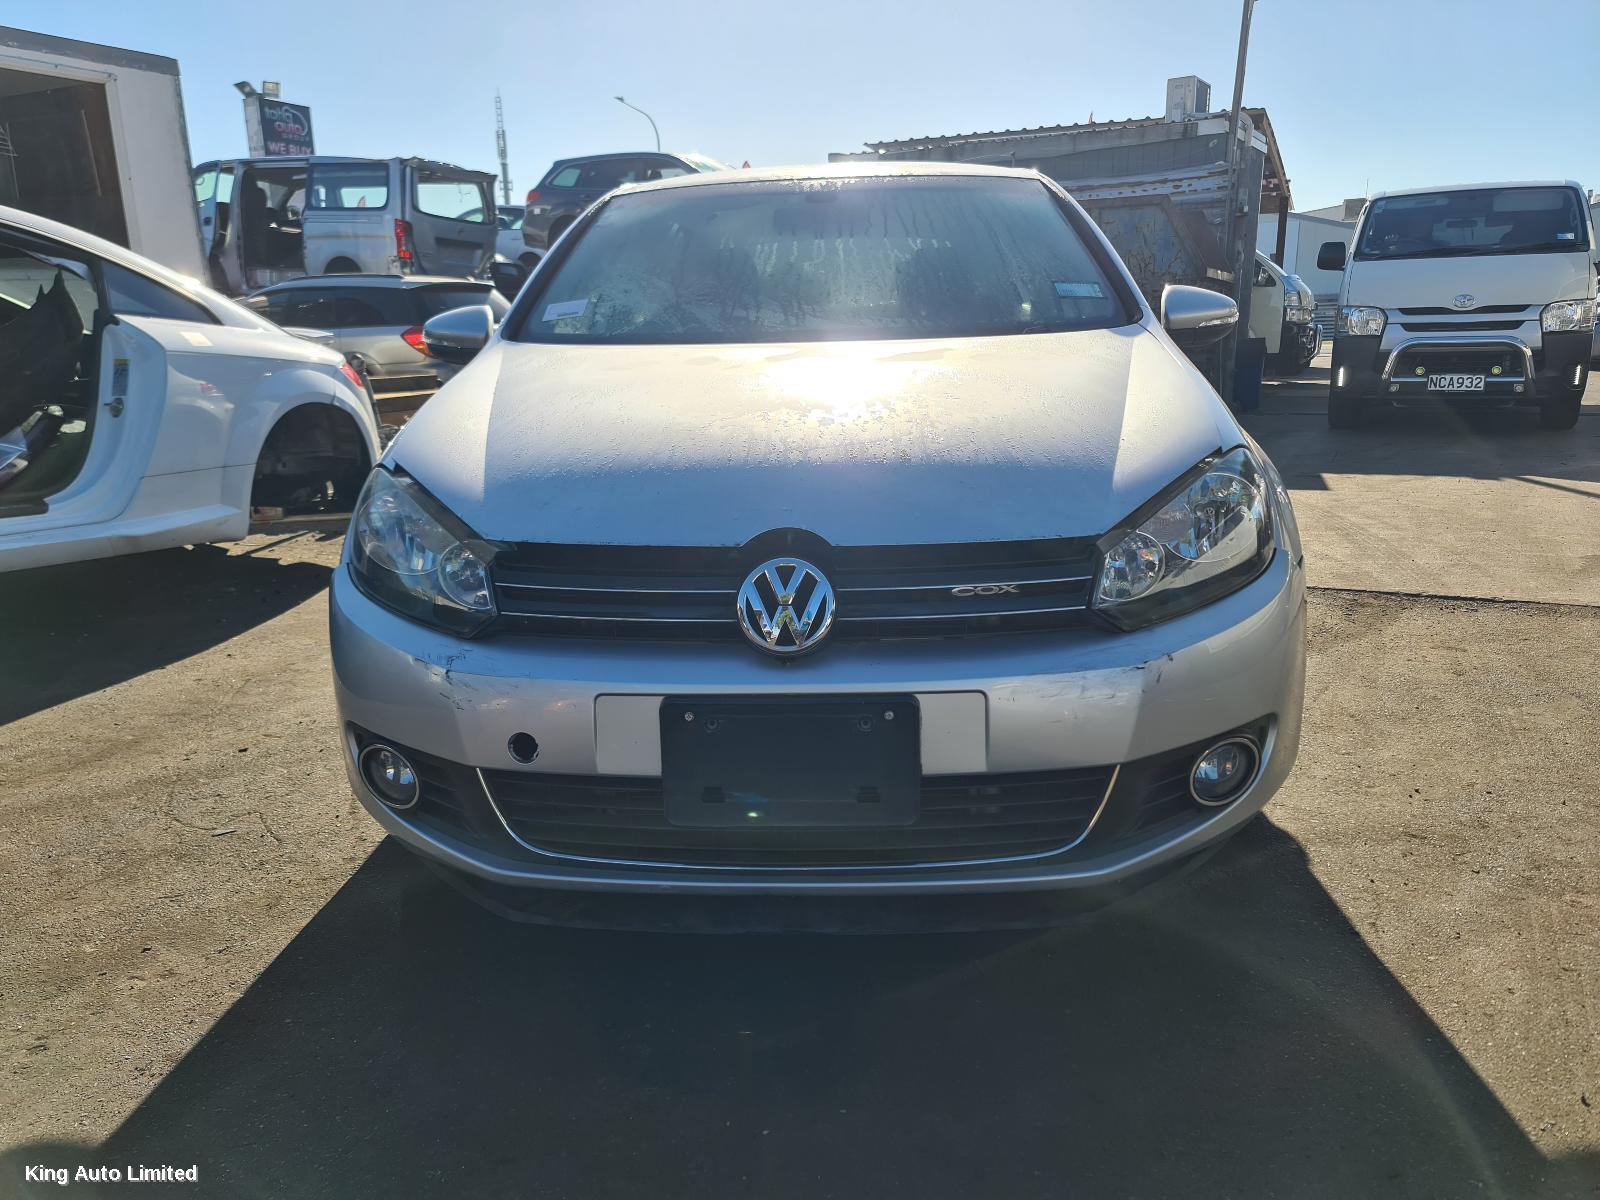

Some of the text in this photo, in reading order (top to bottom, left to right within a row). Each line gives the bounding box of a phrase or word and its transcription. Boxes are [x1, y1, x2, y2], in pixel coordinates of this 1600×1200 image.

[267, 141, 312, 156] WE BUY
[1429, 376, 1483, 389] NCA932
[951, 584, 1020, 597] COX
